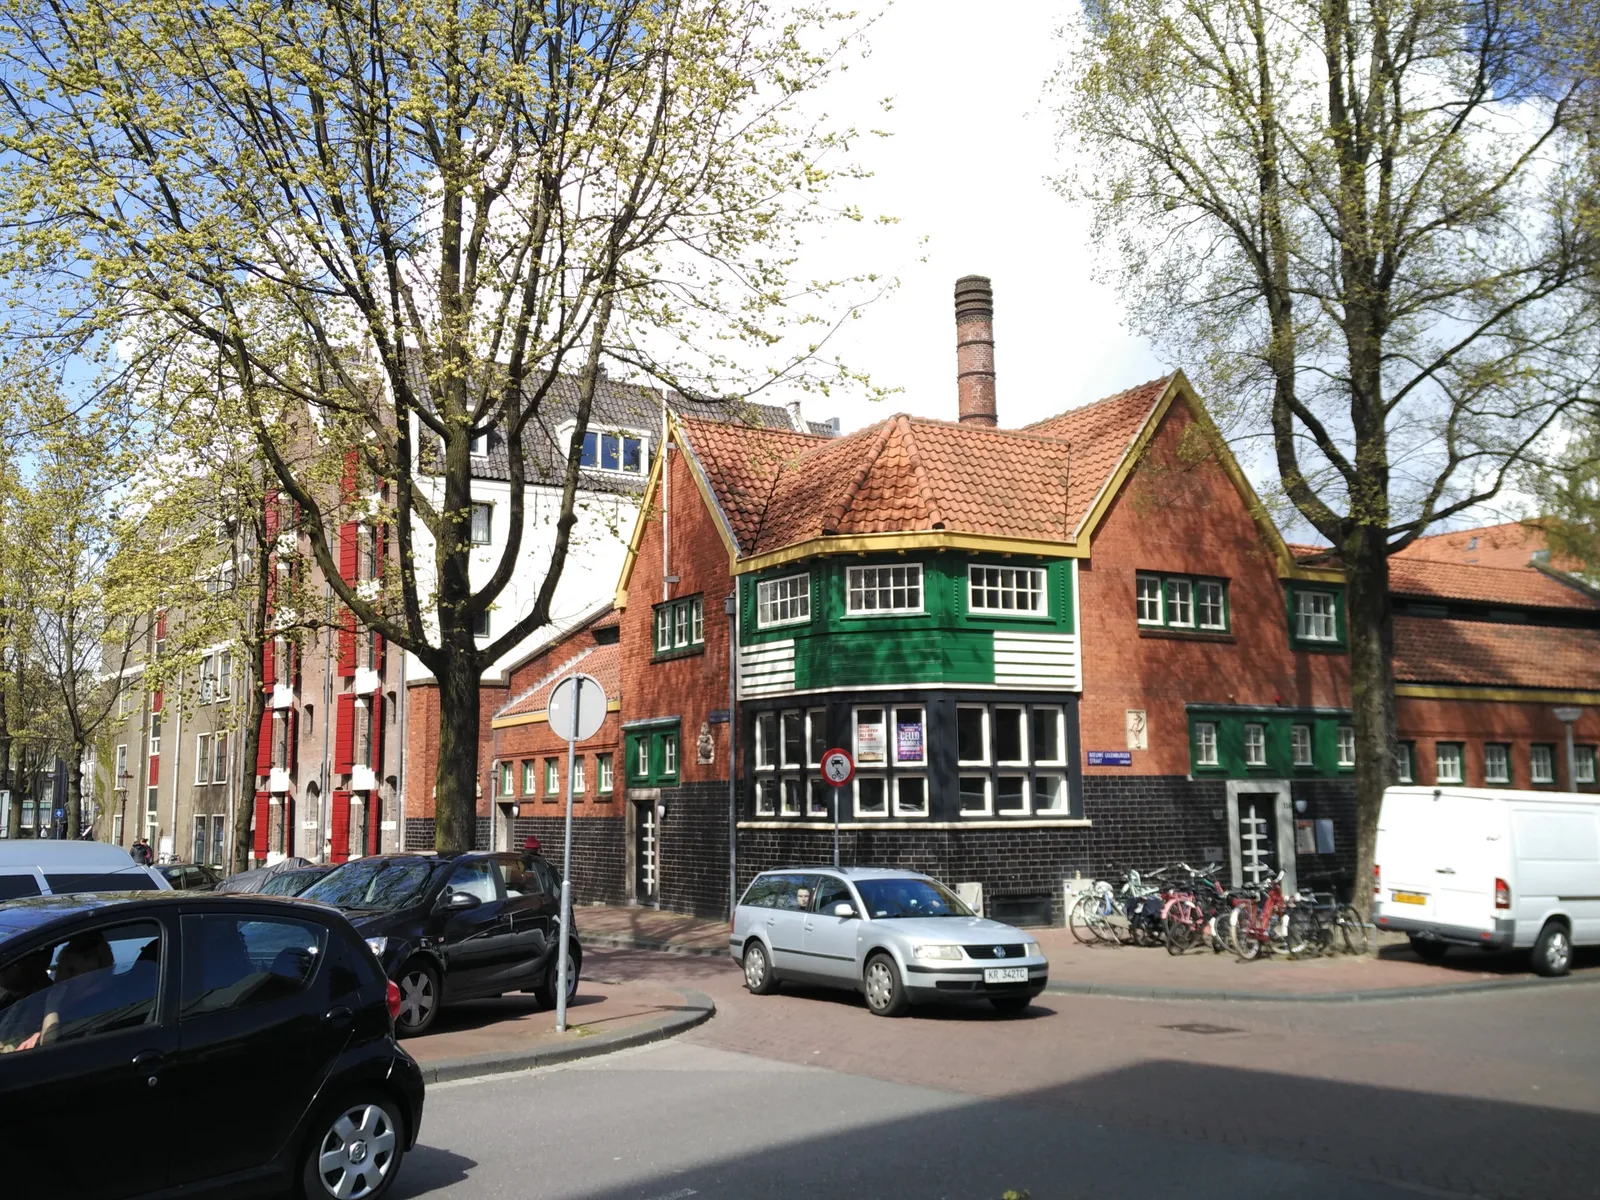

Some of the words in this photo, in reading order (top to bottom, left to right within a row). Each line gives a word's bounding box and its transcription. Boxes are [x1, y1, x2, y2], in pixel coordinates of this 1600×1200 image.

[900, 731, 920, 740] CELLO
[988, 970, 998, 979] KR
[1003, 969, 1024, 979] 342TC
